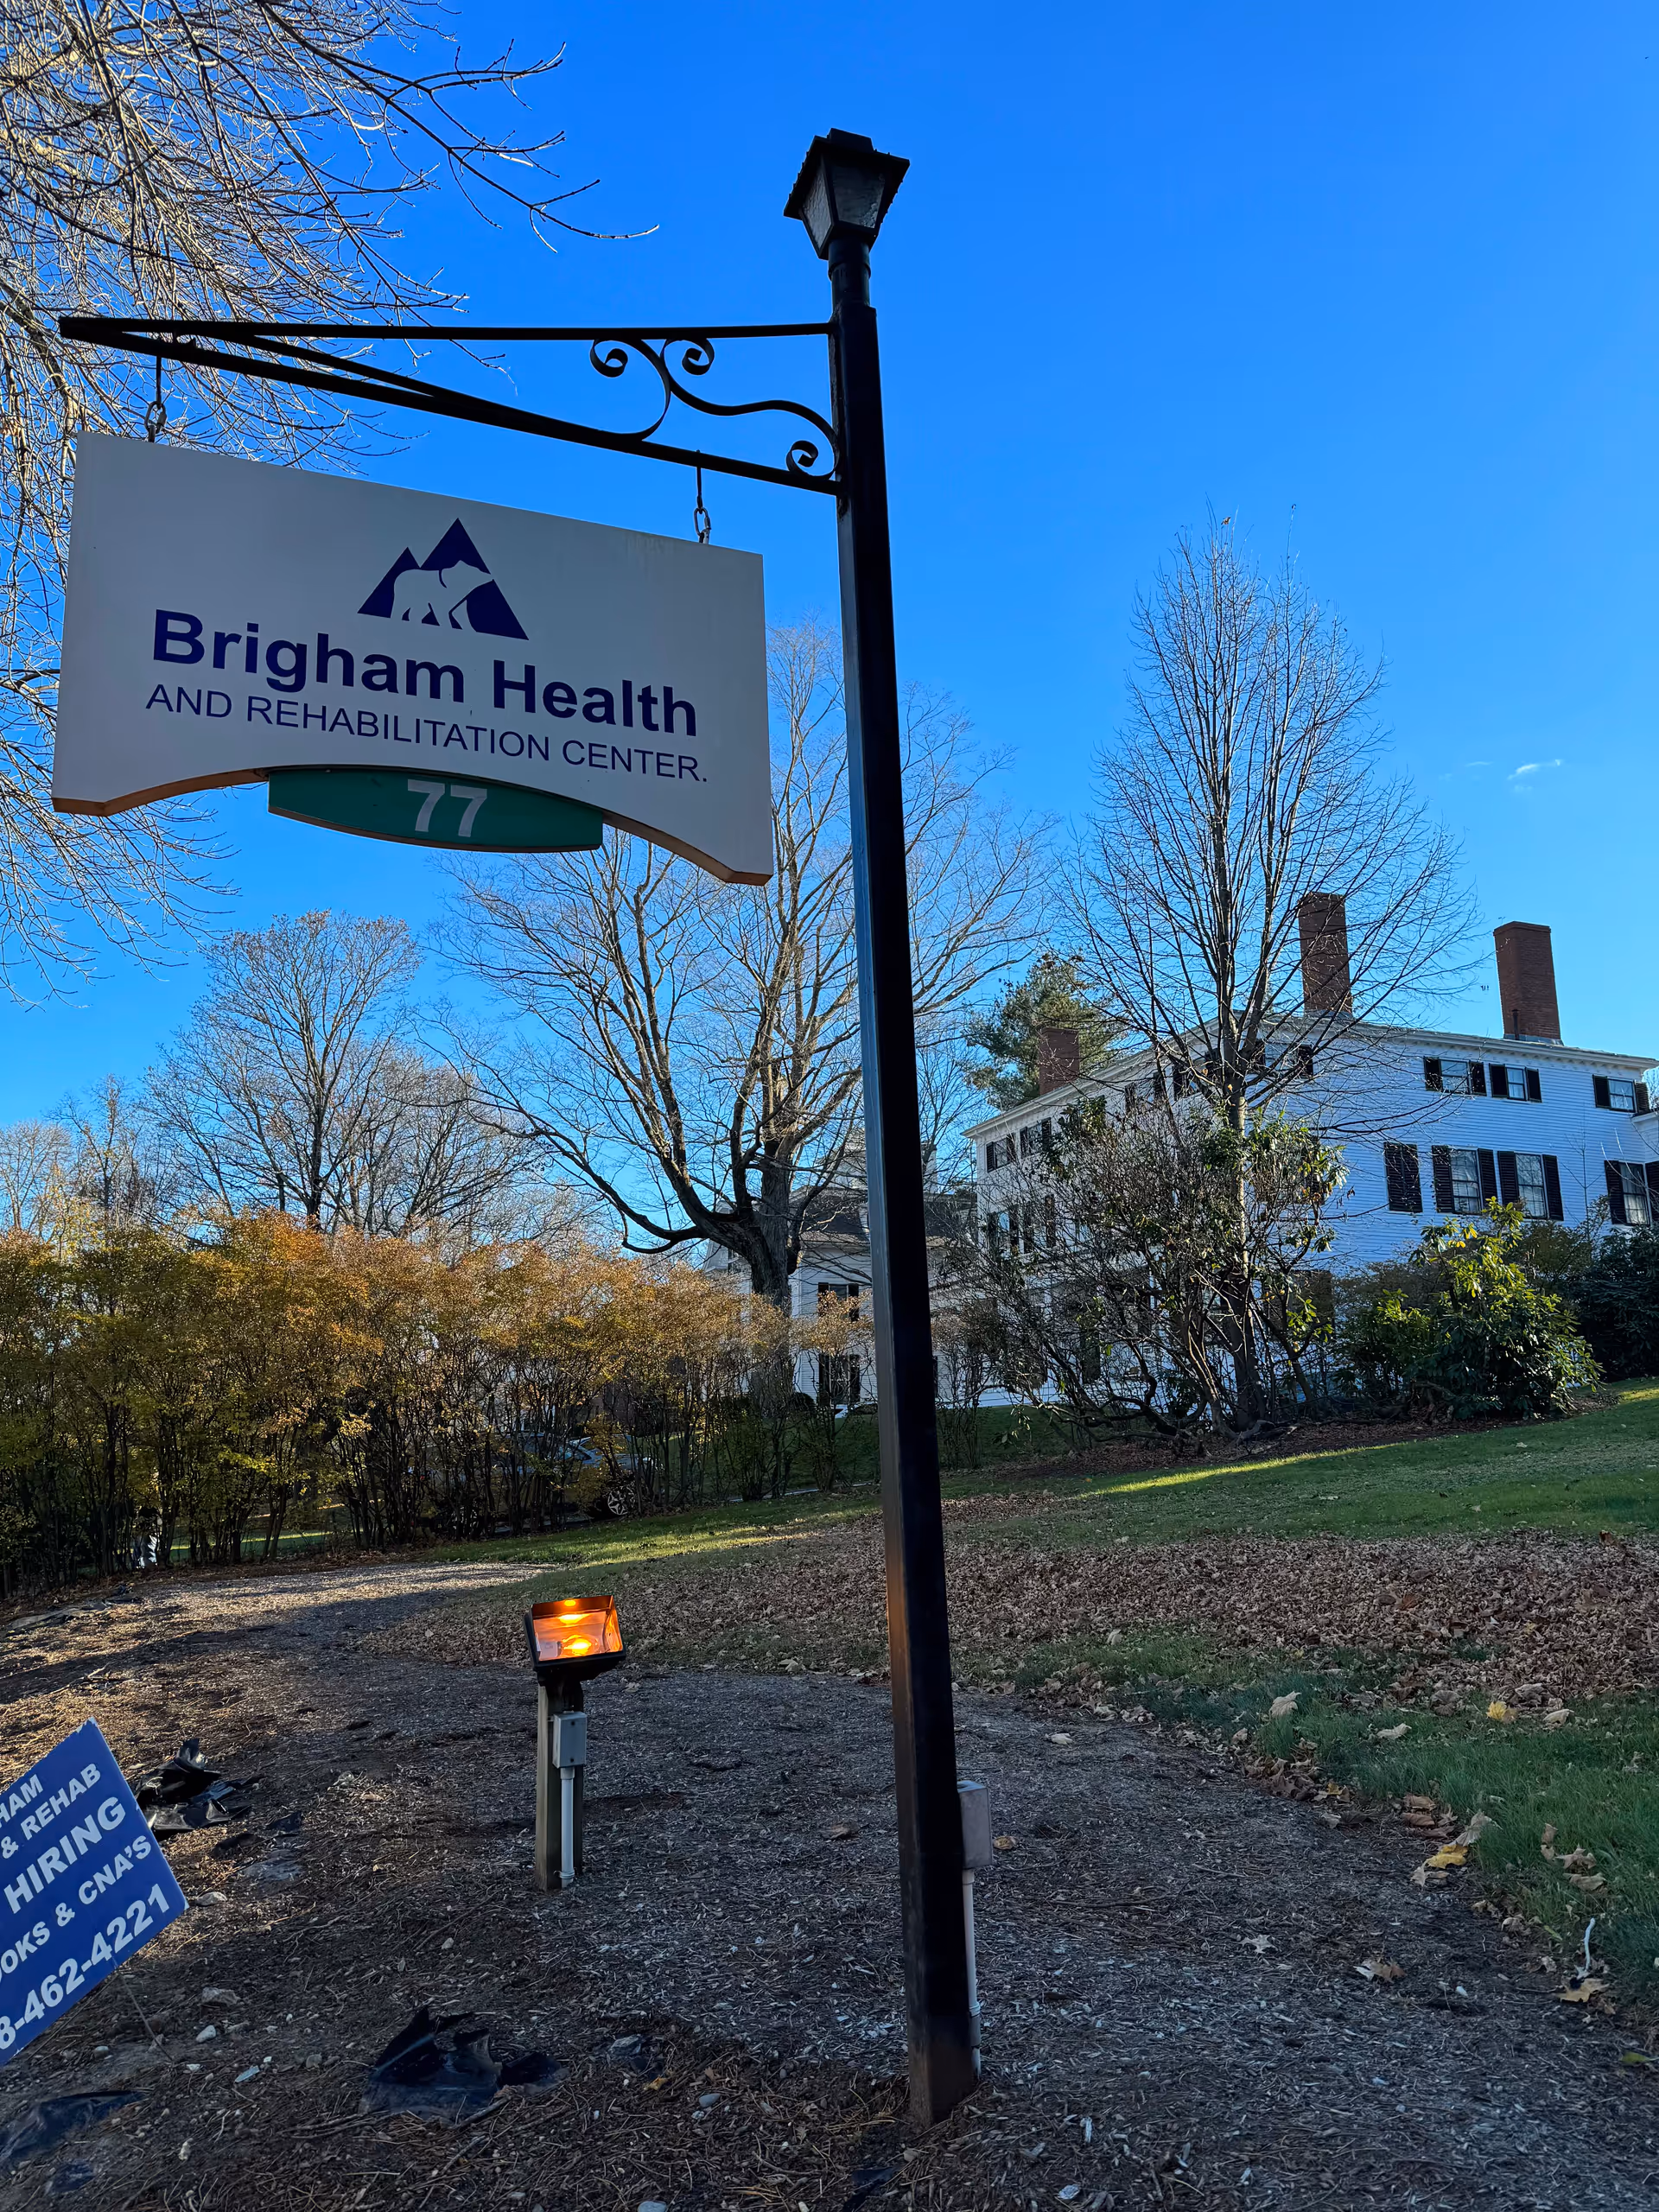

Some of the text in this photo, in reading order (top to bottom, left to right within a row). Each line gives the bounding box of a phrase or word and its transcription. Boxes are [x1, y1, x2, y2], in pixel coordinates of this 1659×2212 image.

[146, 683, 232, 718] AND
[247, 696, 549, 761] REHABILITATION
[153, 609, 696, 738] Brigham Health
[407, 779, 487, 837] 77
[1, 1763, 101, 1859] & REHAB
[3, 1796, 126, 1914] HIRING
[0, 1835, 151, 1982] OKS & CNA'S
[0, 1884, 169, 2050] 8-462-4221
